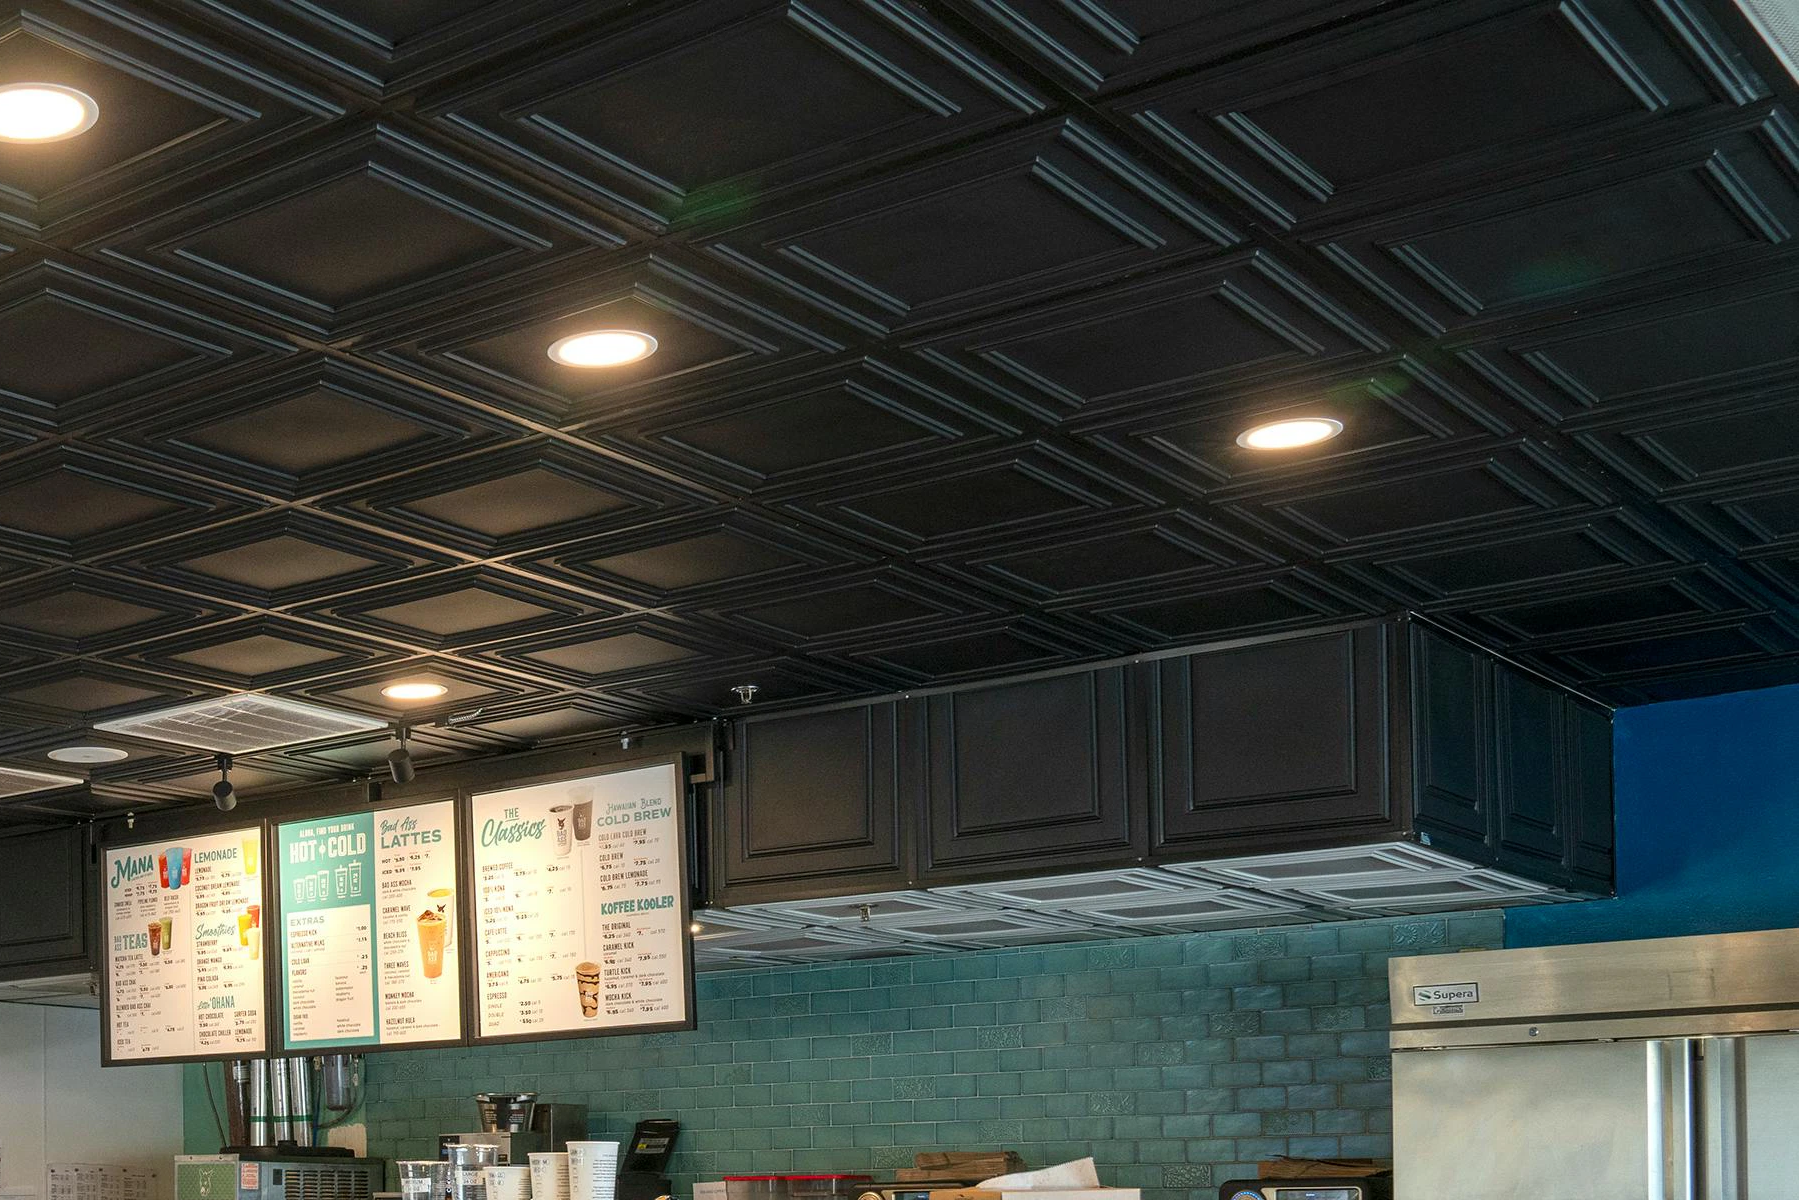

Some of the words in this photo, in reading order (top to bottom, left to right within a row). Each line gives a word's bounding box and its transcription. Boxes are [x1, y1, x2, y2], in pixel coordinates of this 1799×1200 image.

[504, 808, 519, 819] THE
[597, 814, 630, 827] COLD
[634, 807, 672, 821] BREW
[380, 819, 399, 835] Bad
[401, 817, 418, 831] Ass
[481, 818, 546, 847] Classics
[381, 829, 441, 849] LATTES
[599, 833, 610, 841] COLD
[622, 830, 633, 838] COLD
[634, 828, 646, 836] BREW
[289, 840, 317, 864] HOT
[328, 832, 366, 858] COLD
[194, 848, 237, 864] LEMONADE
[600, 854, 610, 862] COLD
[611, 852, 623, 860] BREW
[600, 874, 611, 882] COLD
[612, 873, 624, 881] BREW
[625, 870, 648, 879] LEMONADE
[601, 899, 635, 915] KOFFEE
[637, 895, 674, 910] KOOLER
[290, 916, 325, 927] EXTRAS
[611, 921, 631, 930] ORIGINAL
[195, 922, 236, 940] Smoothies
[123, 933, 148, 950] TEAS
[603, 943, 623, 951] CARAMEL
[605, 993, 620, 1001] MOCHA
[1434, 990, 1473, 1000] Supera
